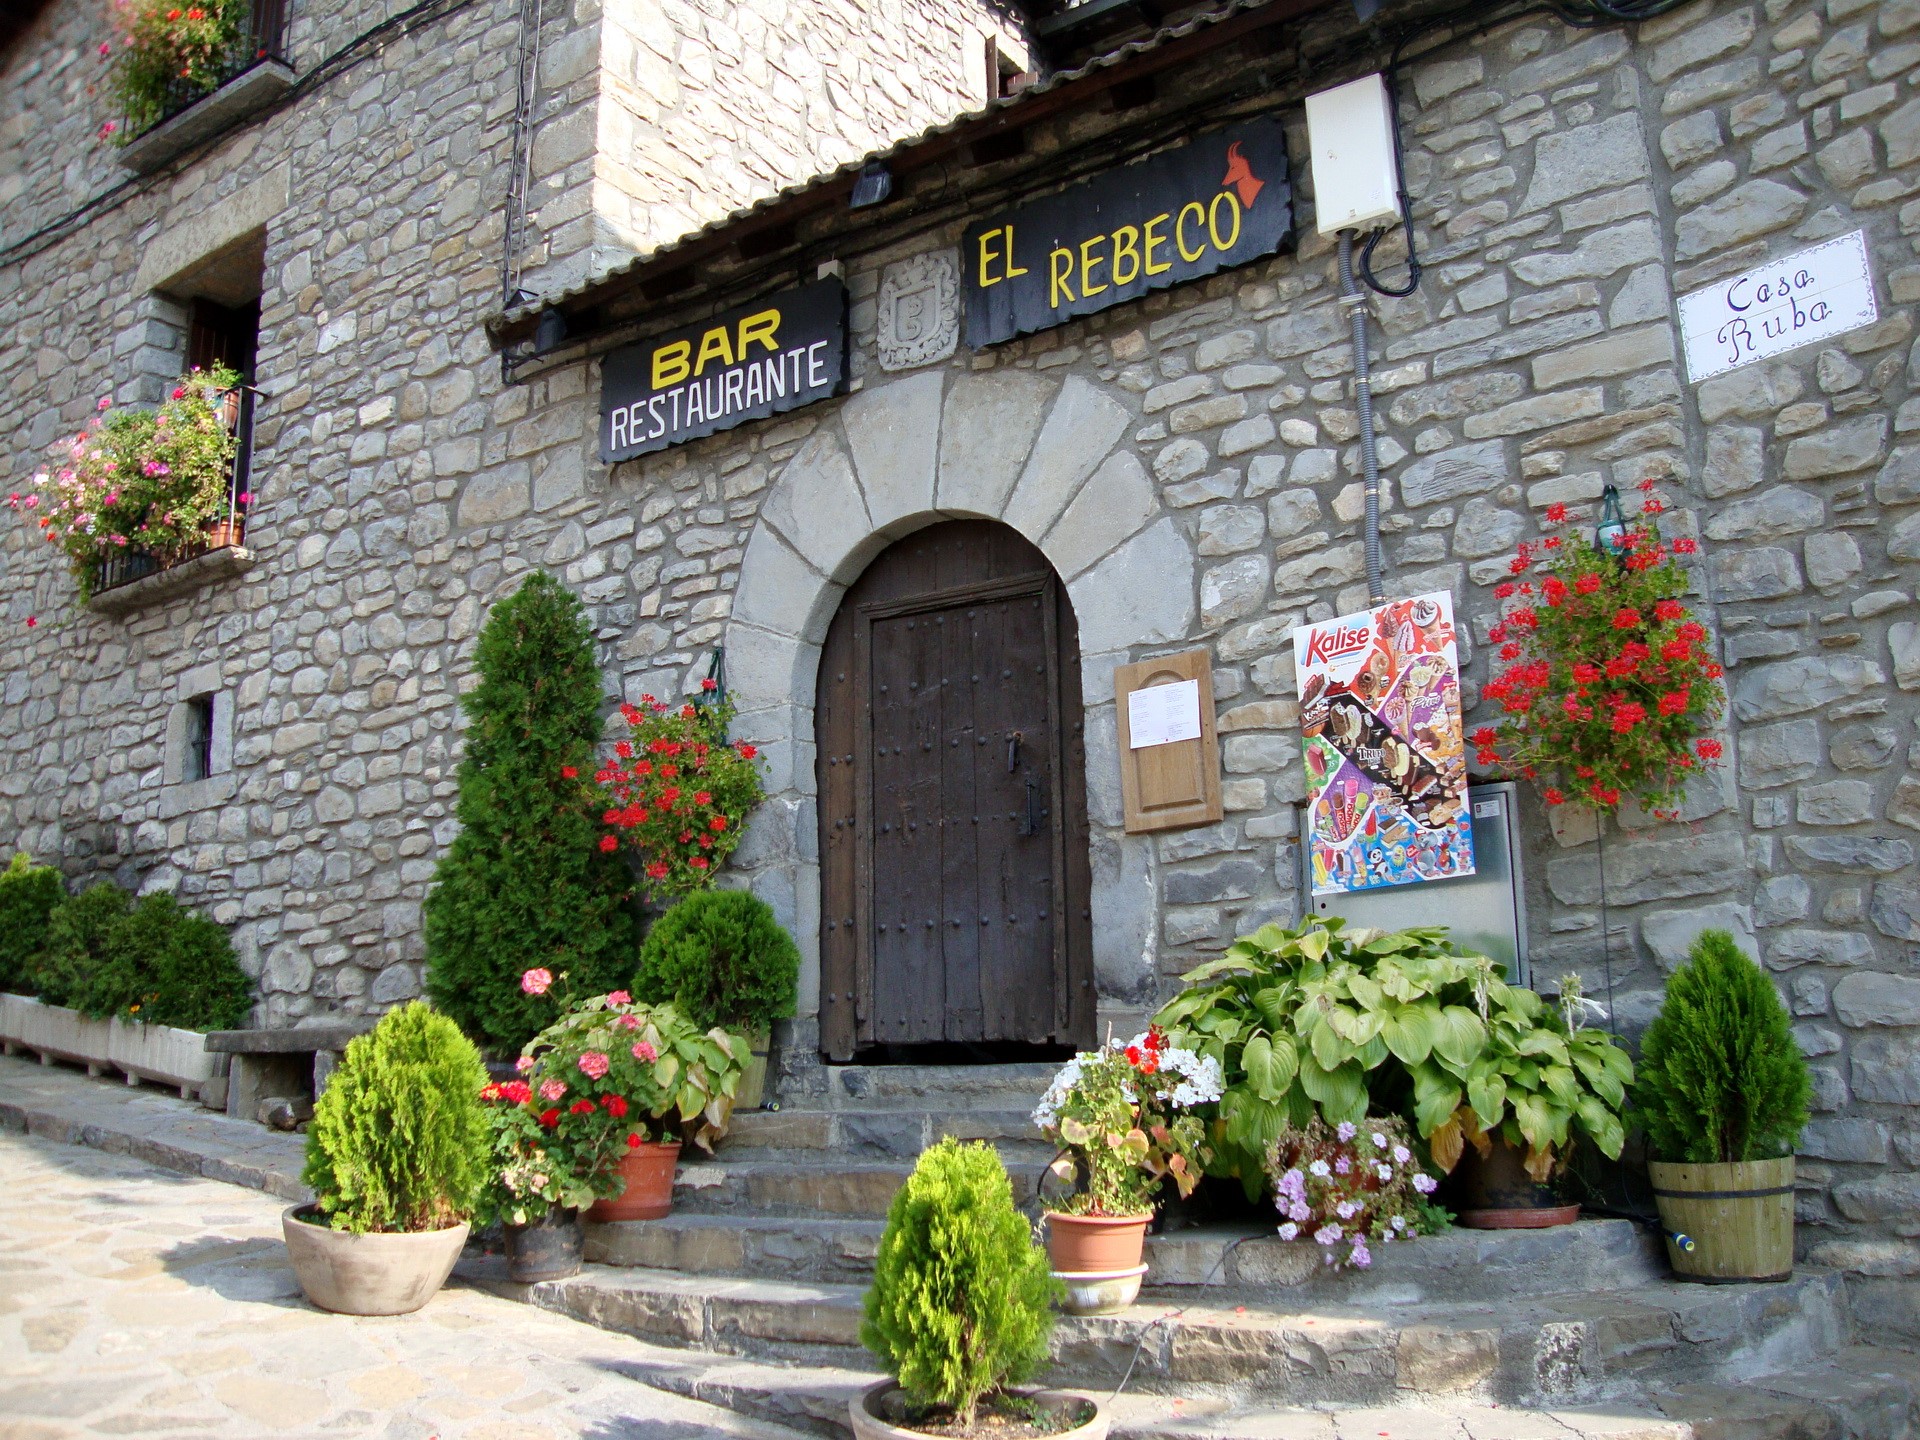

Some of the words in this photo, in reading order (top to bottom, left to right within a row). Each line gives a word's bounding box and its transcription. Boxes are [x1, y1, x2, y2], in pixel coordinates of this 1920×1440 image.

[979, 225, 1028, 288] EL
[1050, 191, 1241, 308] REBECO
[1727, 269, 1815, 312] Casa
[652, 308, 781, 390] BAR
[1717, 297, 1832, 363] Ruba
[611, 340, 828, 451] RESTAURANTE
[1305, 627, 1370, 668] Kalise
